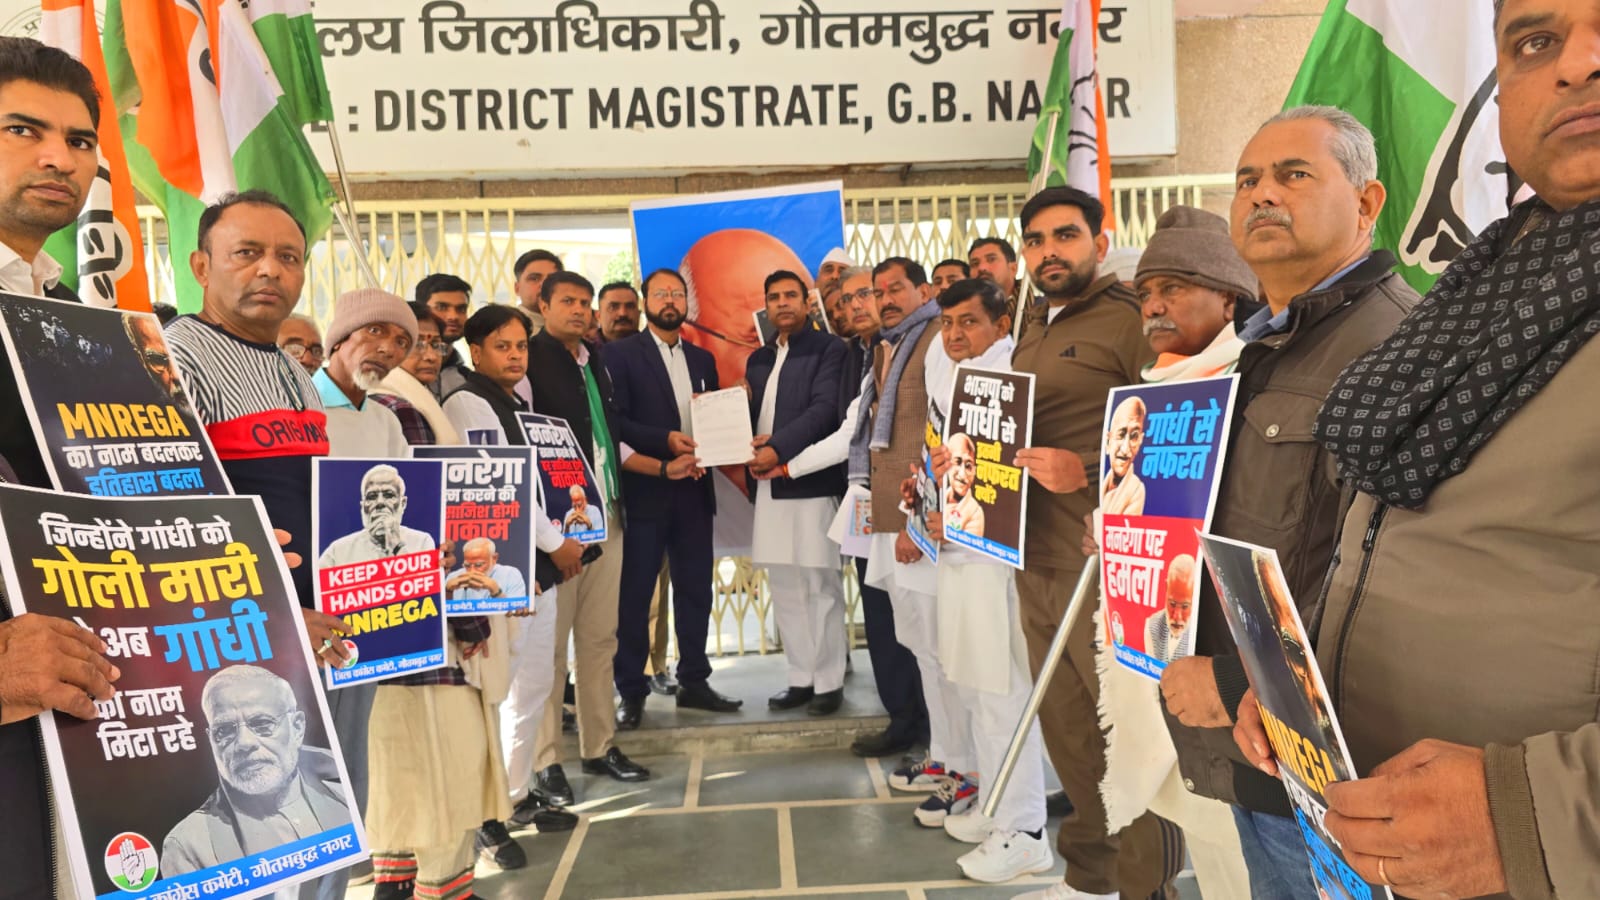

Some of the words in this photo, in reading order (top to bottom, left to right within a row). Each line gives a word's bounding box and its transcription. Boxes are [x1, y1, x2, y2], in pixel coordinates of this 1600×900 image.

[418, 0, 739, 56] जिलाधिकारी,
[759, 1, 994, 65] गौतमबुद्ध
[1007, 7, 1127, 45] नर
[374, 87, 574, 132] DISTRICT
[589, 83, 873, 134] MAGISTRATE,
[887, 82, 972, 124] G.B.
[987, 77, 1132, 123] NAR
[963, 374, 1004, 402] भाजपा
[1001, 382, 1015, 402] को
[56, 403, 191, 439] MNREGA
[958, 399, 1003, 441] गांधी
[1001, 415, 1017, 445] से
[1145, 399, 1197, 446] गांधी
[1192, 397, 1222, 444] से
[62, 445, 94, 469] का
[93, 442, 139, 467] नाम
[136, 441, 203, 464] बदलकर
[447, 449, 526, 485] नरेगा
[1141, 445, 1212, 480] नफरत
[85, 467, 158, 497] इतिहास
[156, 467, 205, 490] बदला
[462, 485, 497, 502] करने
[497, 484, 516, 502] की
[975, 459, 1022, 492] नफरत
[38, 511, 136, 550] जिन्होंने
[136, 516, 196, 549] गांधी
[196, 514, 234, 543] को
[446, 518, 512, 542] ाकाम
[1104, 518, 1144, 557] मनरेगा
[1144, 530, 1168, 557] पर
[31, 545, 150, 609] गोली
[149, 542, 264, 603] मारी
[328, 563, 378, 588] KEEP
[382, 553, 432, 577] YOUR
[1104, 552, 1165, 608] हमला
[329, 583, 397, 612] HANDS
[400, 575, 435, 597] OFF
[100, 626, 152, 658] अब
[154, 598, 274, 672] गांधी
[124, 686, 186, 717] नाम
[97, 720, 159, 761] मिटा
[156, 715, 197, 753] रहे
[201, 866, 250, 896] कमेटी,
[249, 846, 319, 879] गौतमबुद्ध
[319, 833, 353, 859] नगर
